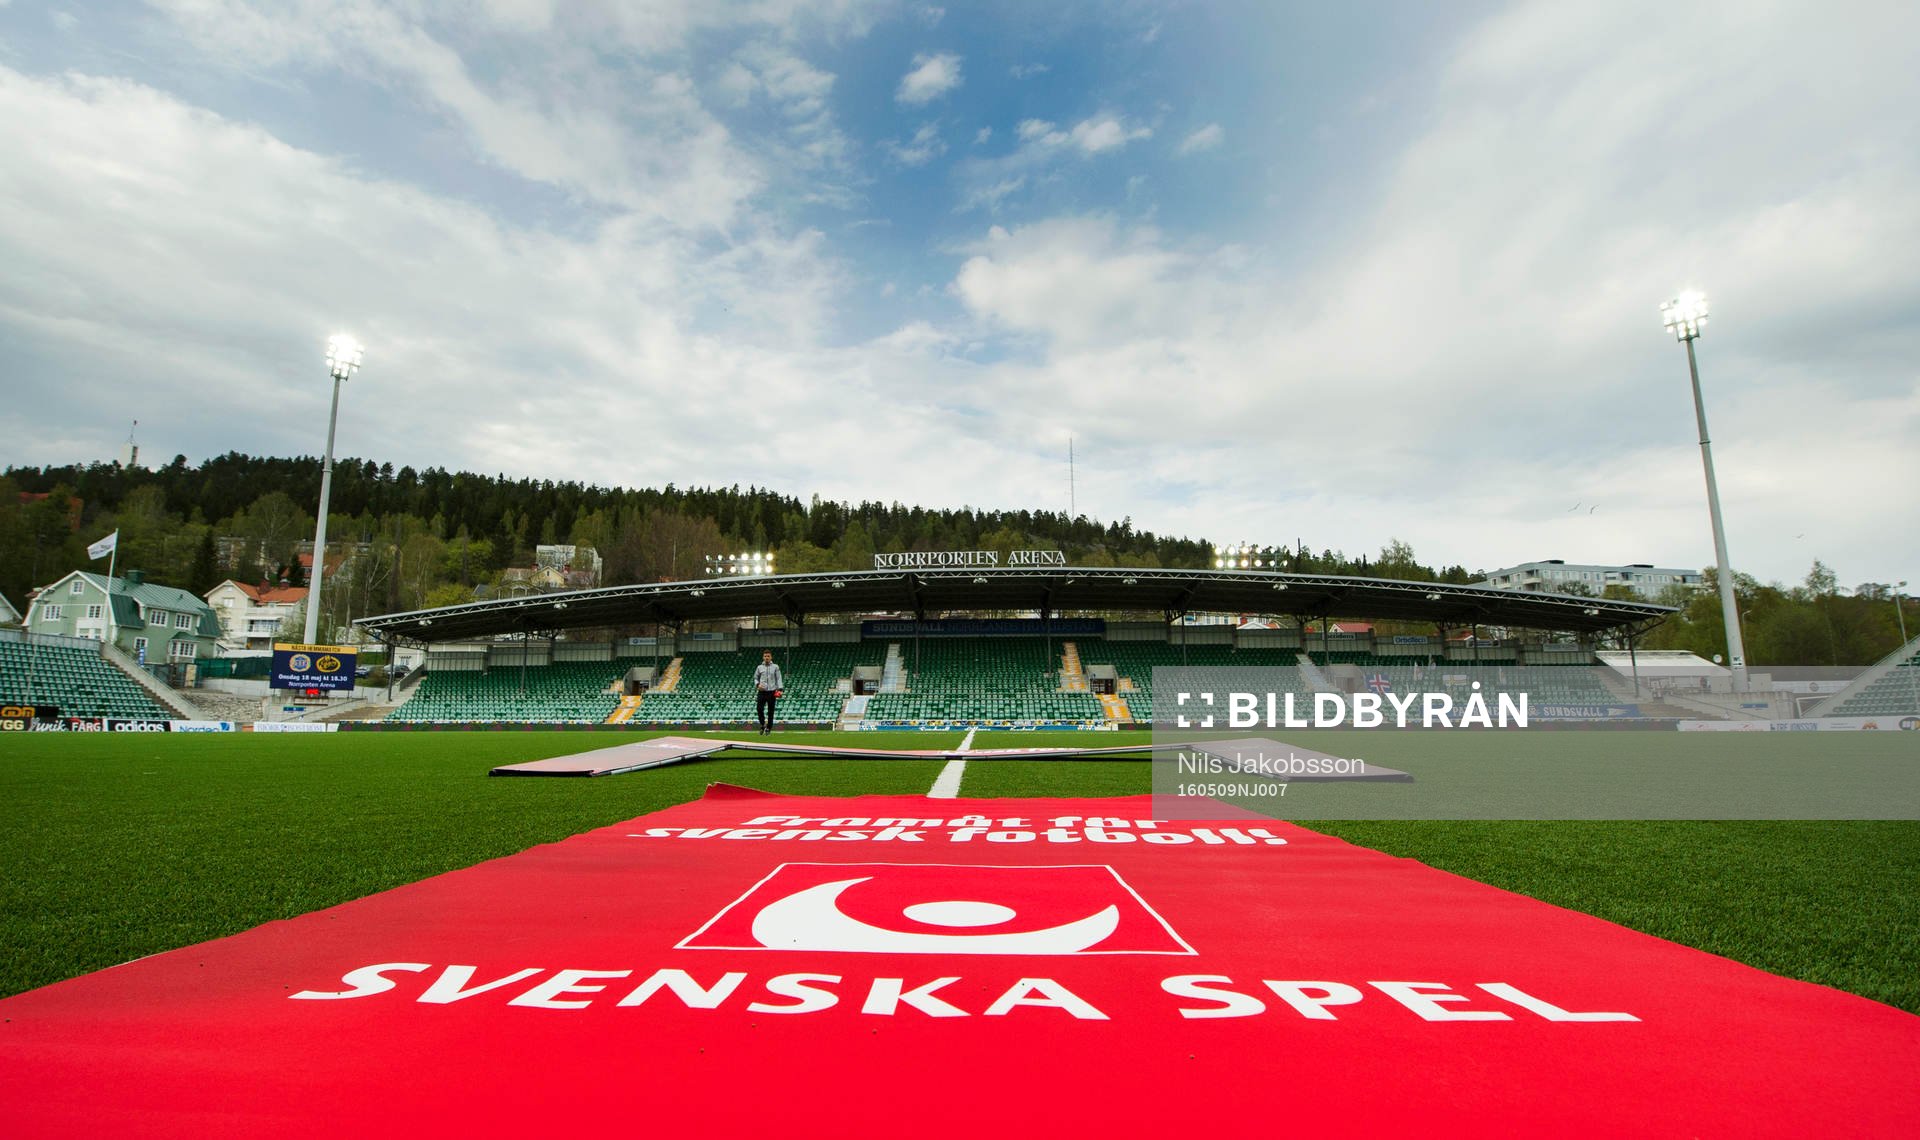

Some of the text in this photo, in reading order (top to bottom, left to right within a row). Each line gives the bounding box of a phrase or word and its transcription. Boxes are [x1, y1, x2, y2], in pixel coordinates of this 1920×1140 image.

[875, 550, 1066, 567] NORRPORTEN ARENA
[872, 622, 944, 632] SUNDSVALL
[1543, 706, 1604, 717] SUNDSVALL
[115, 721, 165, 732] adidas
[740, 814, 1169, 829] Framåt för
[626, 826, 1288, 845] svensk fotboll!
[288, 962, 1641, 1022] SVENSKA SPEL
